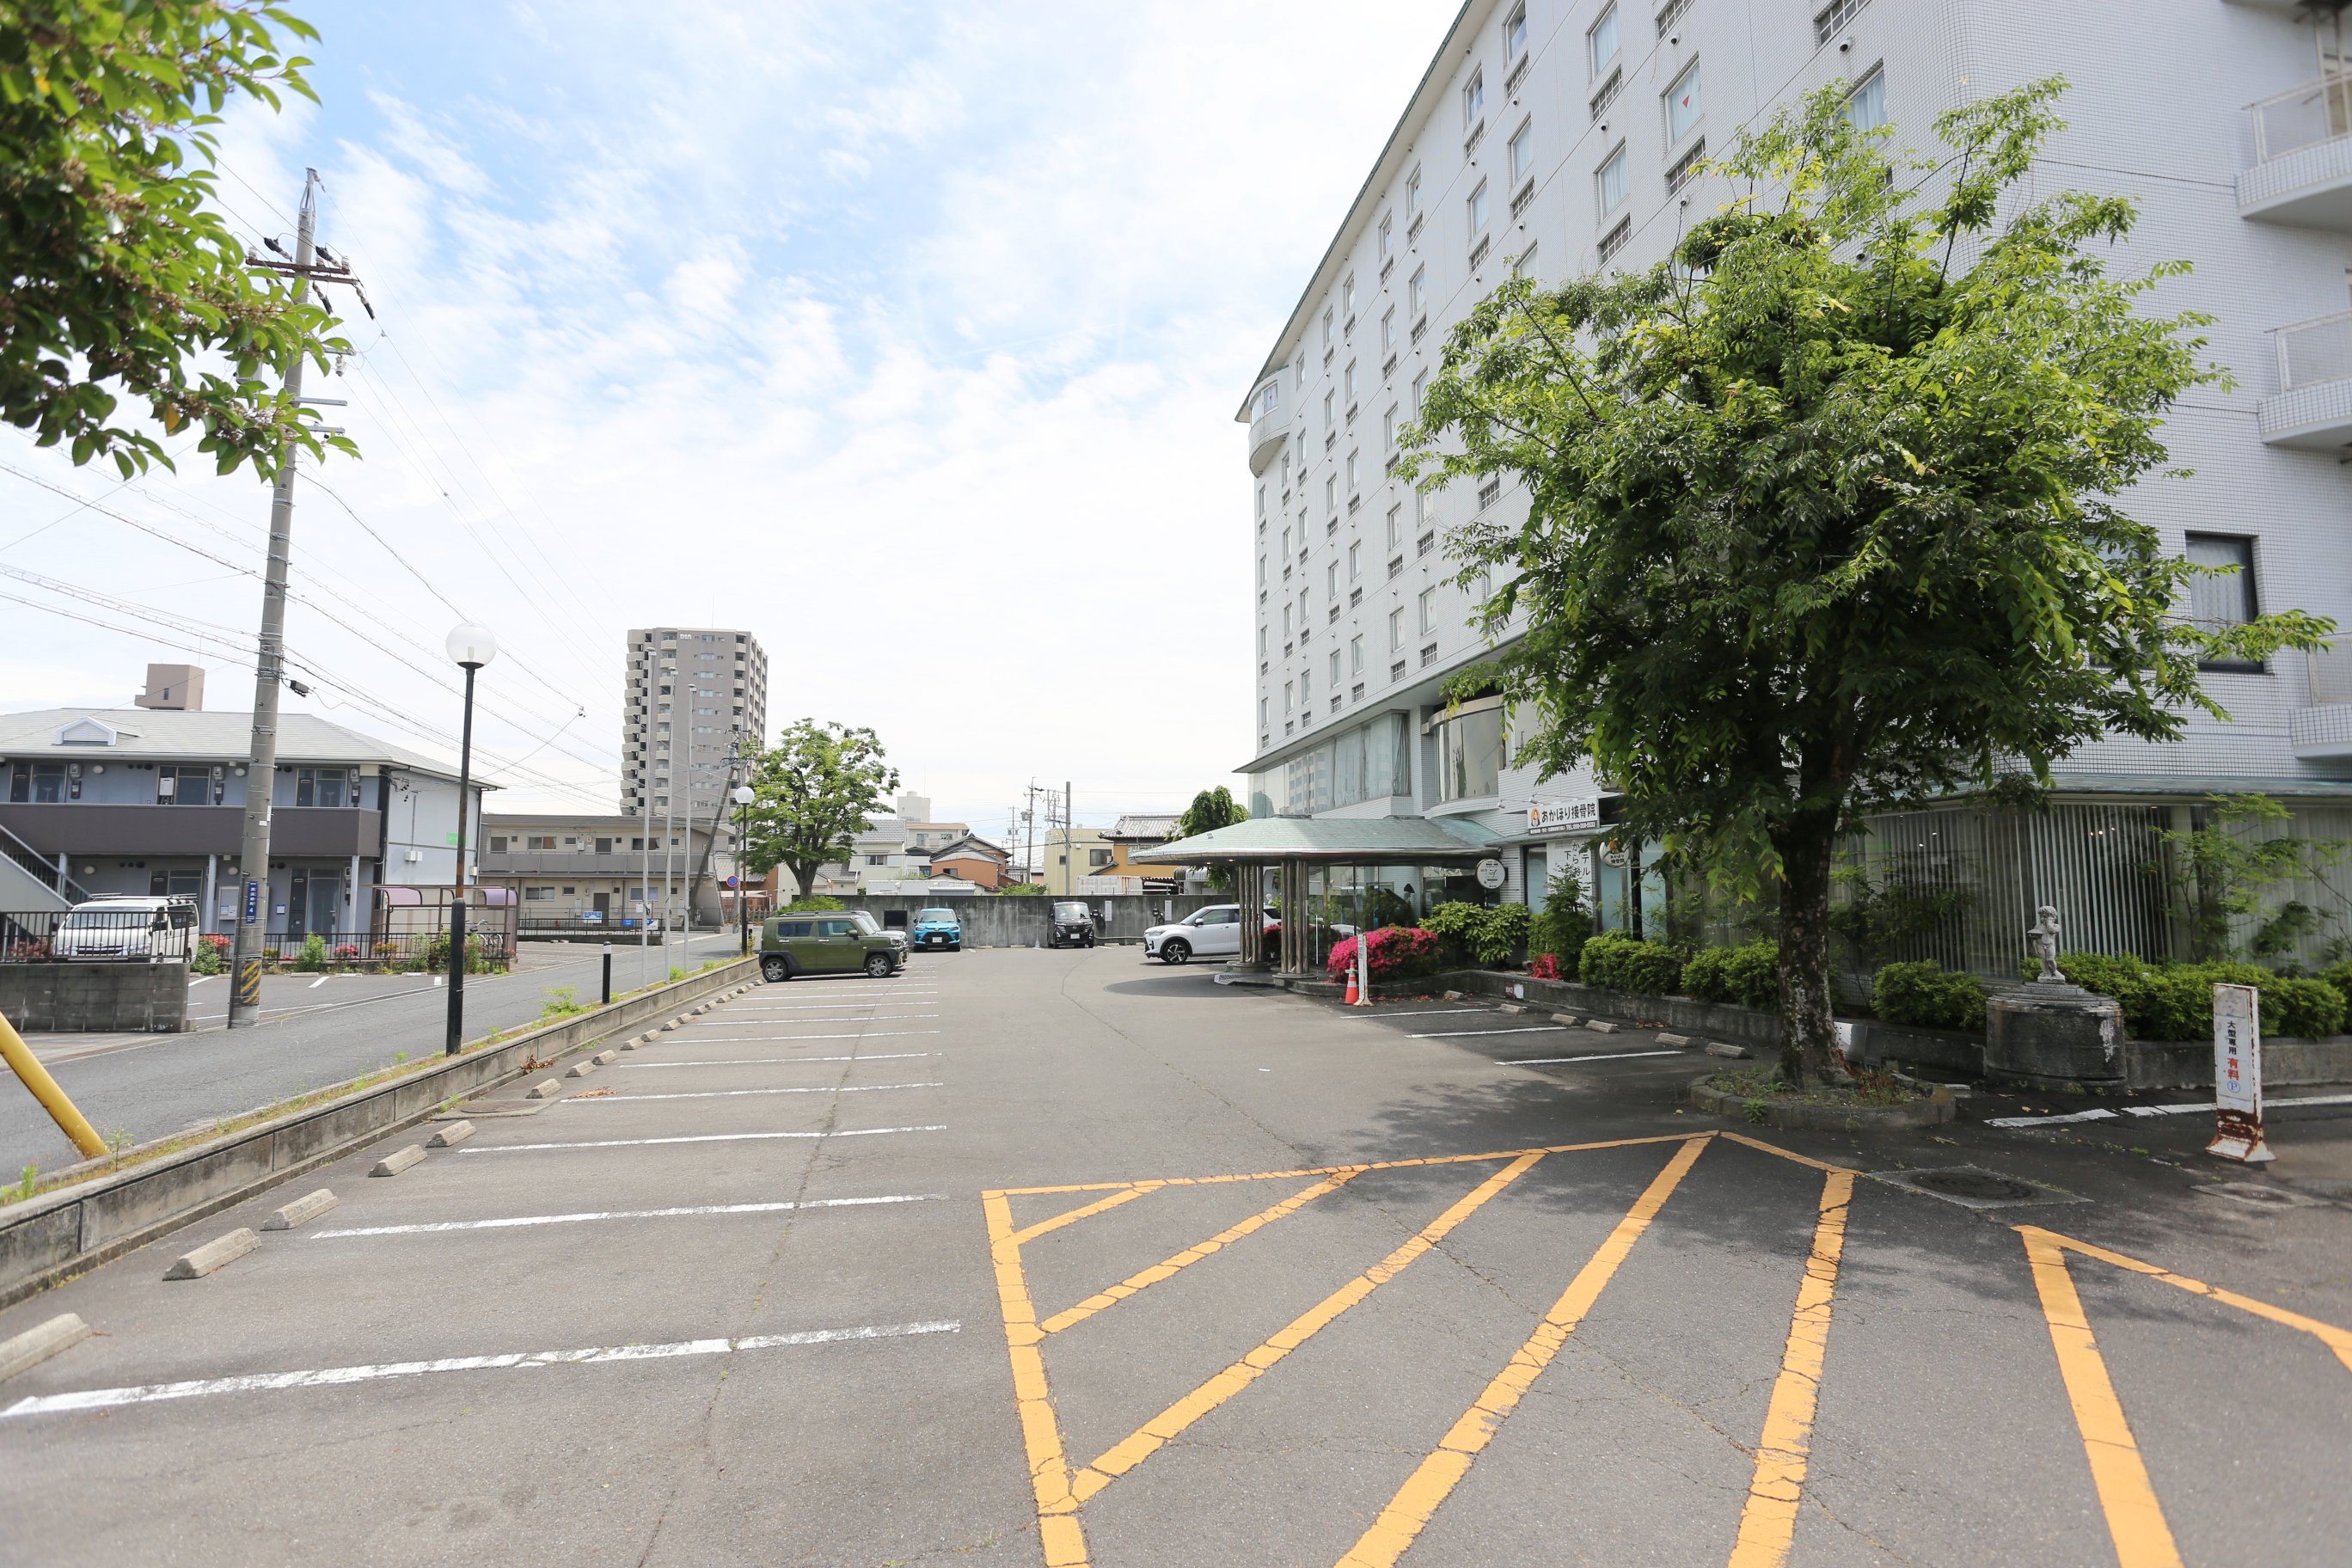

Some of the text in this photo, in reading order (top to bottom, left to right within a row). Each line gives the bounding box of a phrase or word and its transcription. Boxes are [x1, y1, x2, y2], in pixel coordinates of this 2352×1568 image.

[1541, 802, 1596, 823] あかほり接骨院
[2226, 1057, 2239, 1081] 有料
